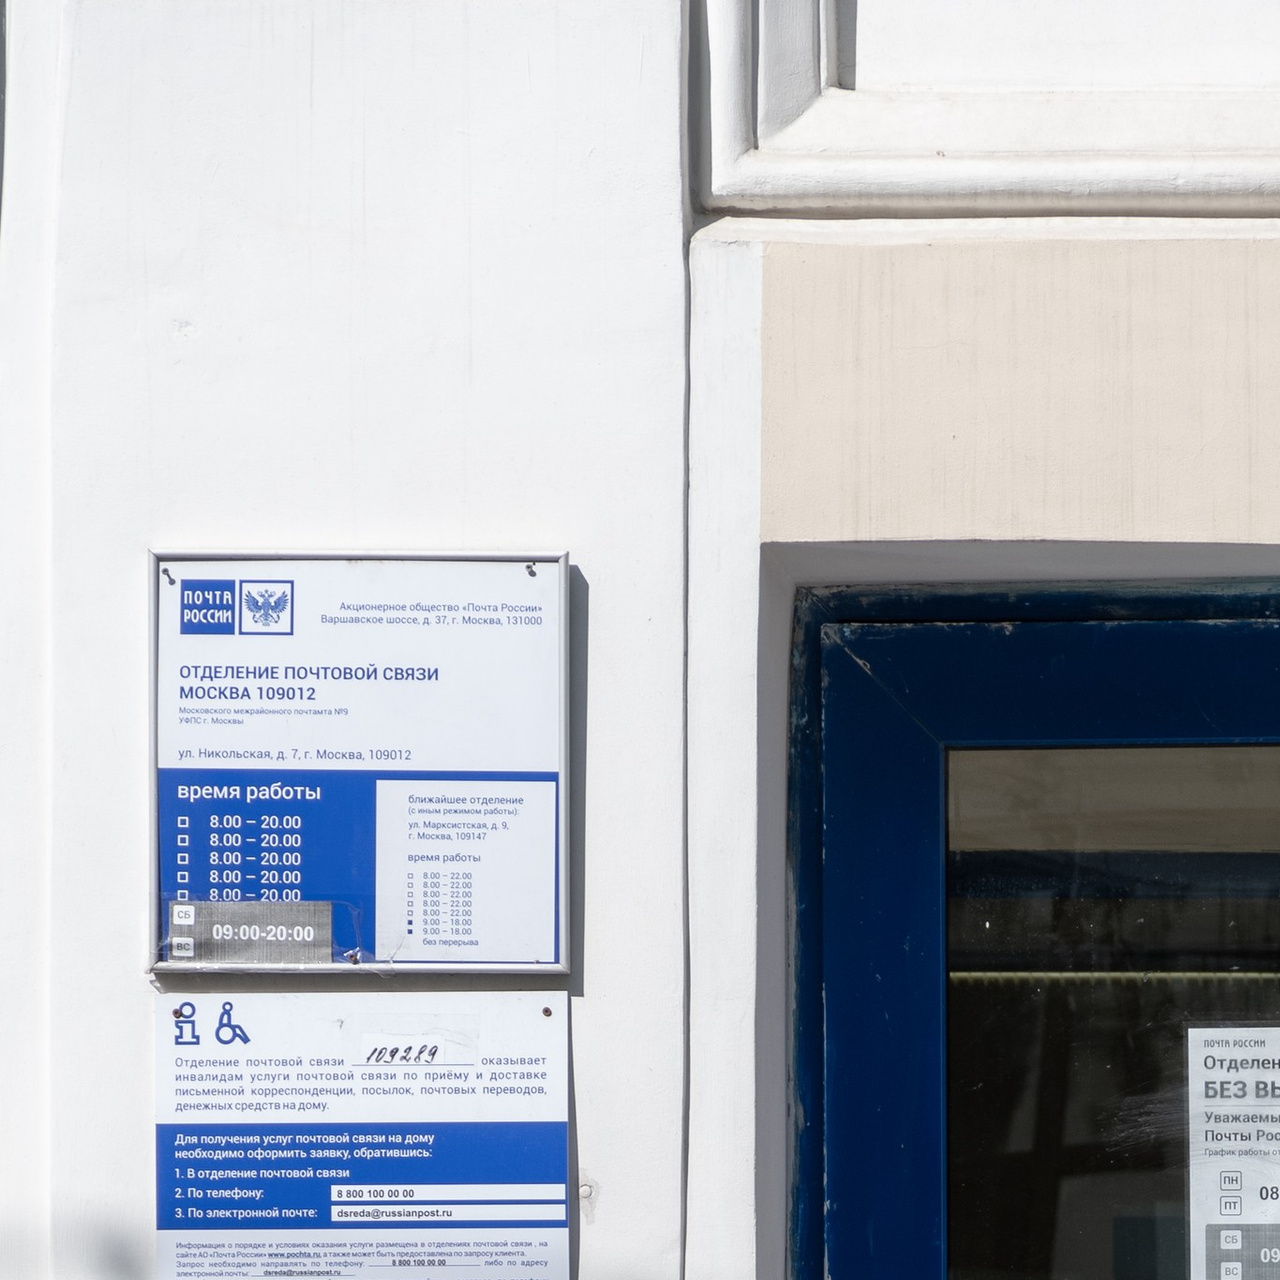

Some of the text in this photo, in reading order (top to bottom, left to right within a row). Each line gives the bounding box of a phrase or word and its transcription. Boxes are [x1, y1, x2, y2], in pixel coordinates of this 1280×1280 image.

[184, 591, 232, 605] ПОЧТА
[339, 602, 542, 613] Акционерное общество «Почта России»
[184, 609, 232, 623] РОССИИ
[321, 614, 384, 625] Варшавское
[386, 617, 420, 625] шоссе,
[422, 617, 431, 626] д.
[435, 615, 449, 625] 37,
[462, 616, 503, 626] Москва,
[507, 616, 542, 625] 131000
[180, 664, 438, 682] ОТДЕЛЕНИЕ ПОЧТОВОЙ СВЯЗИ
[180, 686, 316, 700] МОСКВА 109012
[233, 707, 292, 716] межрайонного
[334, 708, 348, 716] №9
[178, 748, 411, 761] ул. Никольская, д. 7, г. Москва, 109012
[178, 782, 320, 803] время работы
[408, 794, 524, 806] ближайшее отделение
[210, 815, 301, 829] 8.00 20.00
[408, 821, 509, 831] ул. Марксистская, д. 9,
[417, 832, 453, 841] Москва,
[456, 832, 487, 840] 109147
[408, 853, 481, 863] время работы
[423, 872, 472, 880] 8.00 22.00
[210, 888, 301, 902] 8.00 20.00
[177, 910, 191, 919] СБ
[213, 924, 314, 941] 09:00-20:00
[176, 943, 191, 951] ВС
[422, 938, 479, 947] без перерыва
[1204, 1039, 1266, 1048] ПОЧТА РОССИИ
[175, 1056, 344, 1069] Отделение почтовой связи
[481, 1057, 546, 1065] оказывает
[1205, 1081, 1247, 1099] БЕЗ
[174, 1133, 435, 1146] Для получения услуг почтовой связи на дому
[1205, 1130, 1251, 1142] Почты
[1204, 1148, 1236, 1156] График
[1238, 1147, 1270, 1157] работы
[1223, 1176, 1238, 1185] ПН
[175, 1187, 264, 1200] 2. По телефону:
[337, 1189, 414, 1198] 8 800 100 00 00
[1224, 1201, 1238, 1210] ПТ
[175, 1207, 317, 1220] 3. По электронной почте:
[337, 1209, 453, 1221] dsreda@russianpost.ru
[1224, 1235, 1238, 1244] СБ
[1225, 1267, 1238, 1276] ВС
